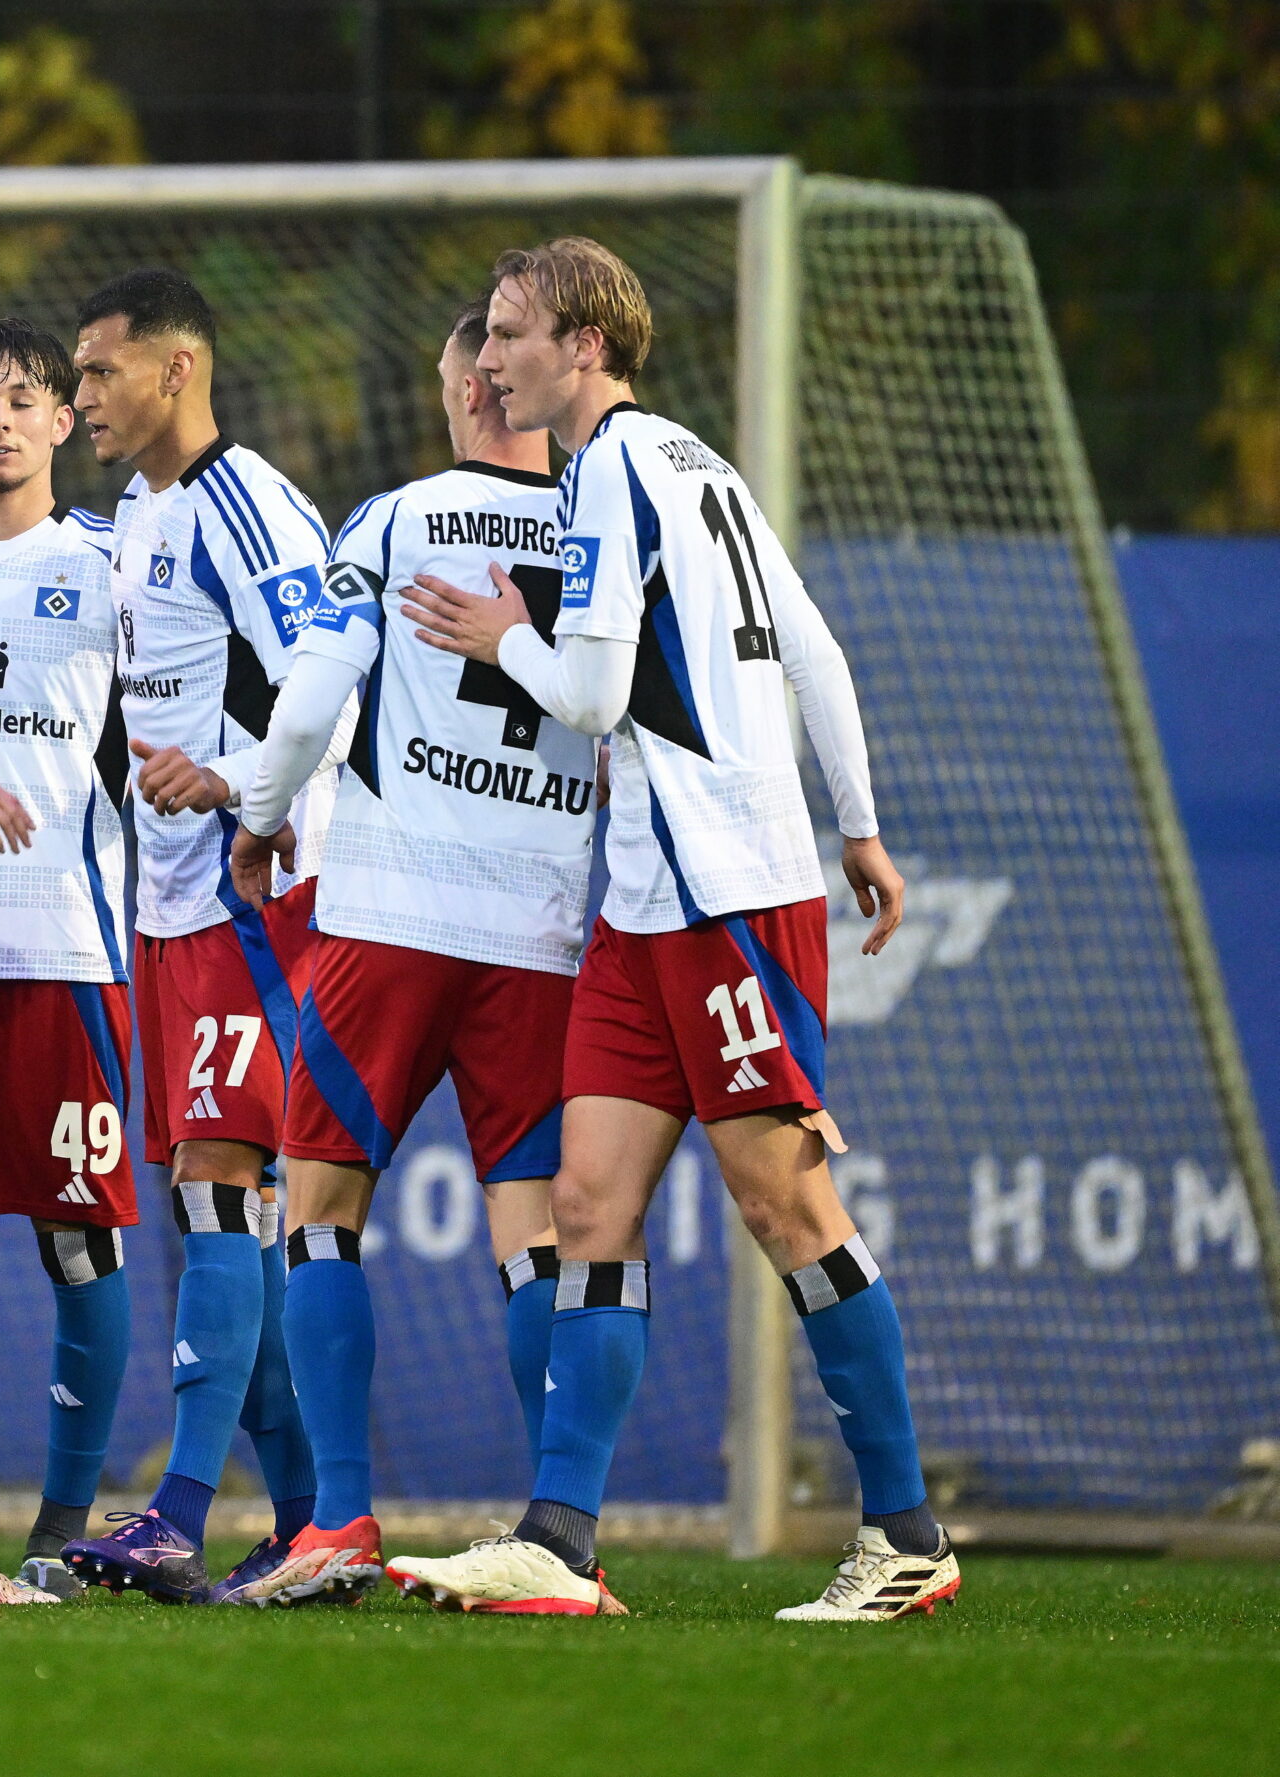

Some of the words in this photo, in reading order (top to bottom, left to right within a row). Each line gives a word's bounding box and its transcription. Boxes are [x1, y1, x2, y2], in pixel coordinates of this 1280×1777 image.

[425, 511, 560, 556] HAMBURG
[700, 483, 781, 663] 11
[403, 737, 593, 816] SCHONLAU
[188, 1014, 262, 1088] 27
[706, 975, 781, 1062] 11
[51, 1101, 121, 1175] 49
